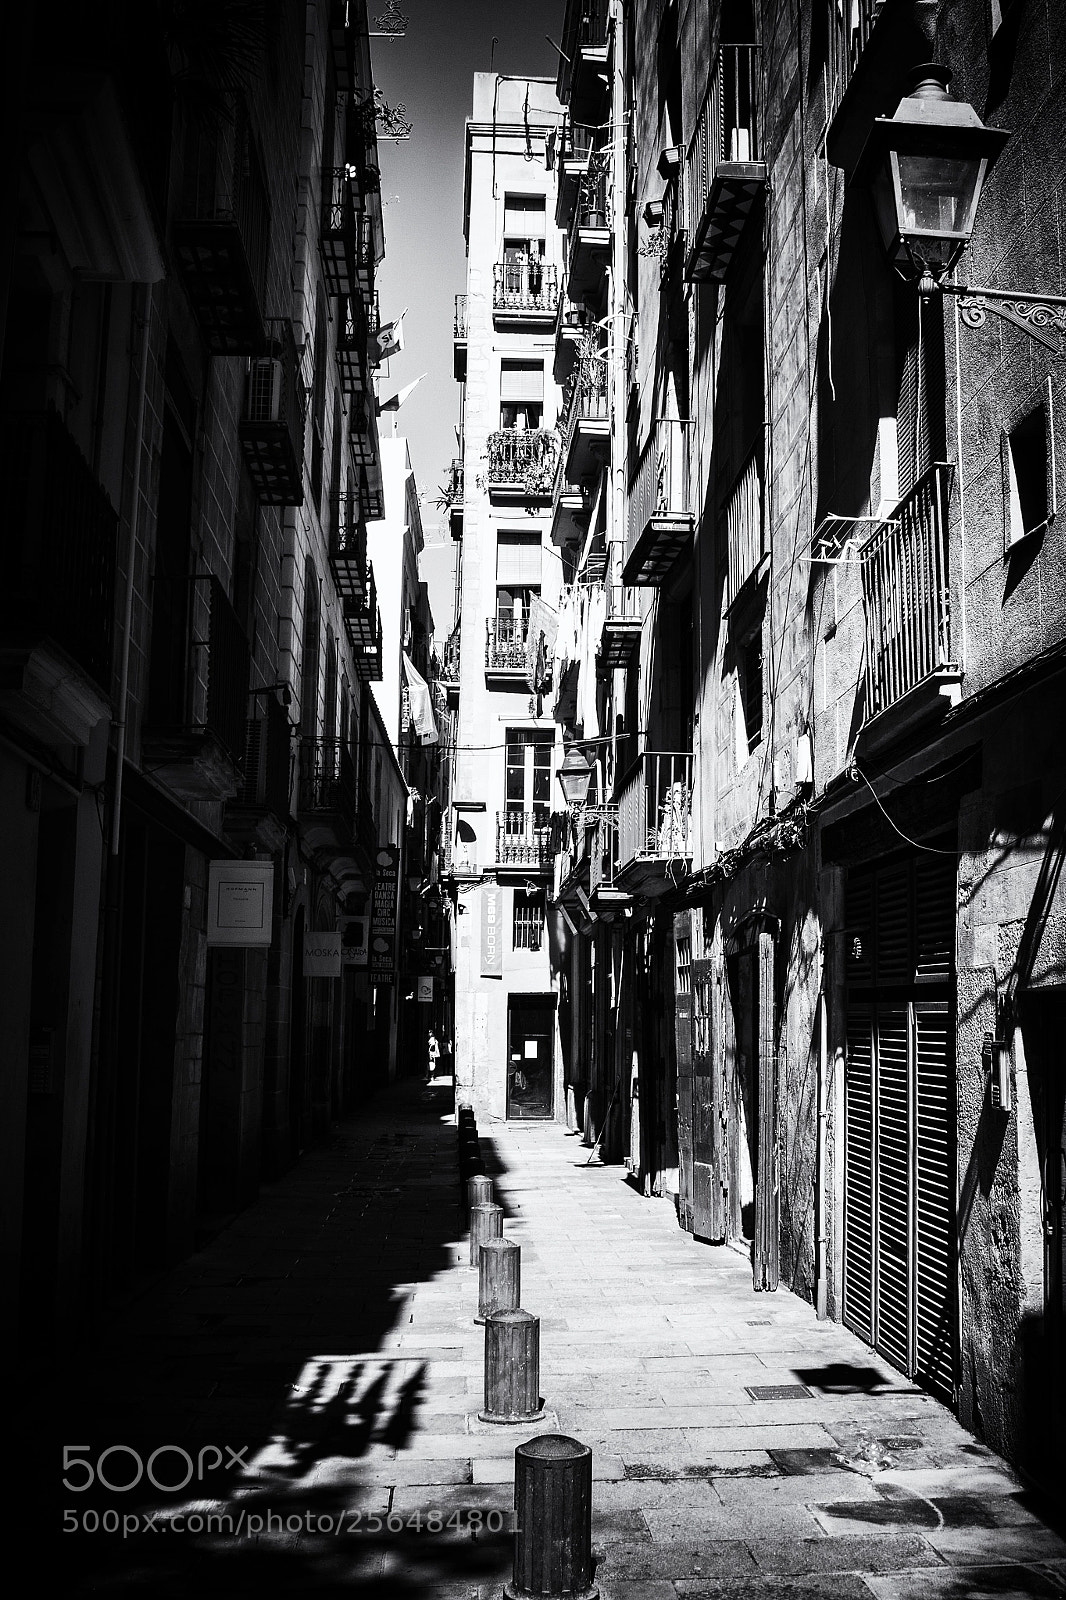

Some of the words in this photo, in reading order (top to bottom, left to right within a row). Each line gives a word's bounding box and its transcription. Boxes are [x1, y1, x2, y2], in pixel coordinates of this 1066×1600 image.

[374, 891, 395, 900] DANSA
[487, 893, 496, 924] M69
[487, 926, 496, 965] BORN
[305, 948, 339, 957] MOSKA
[370, 973, 393, 983] TEATRE
